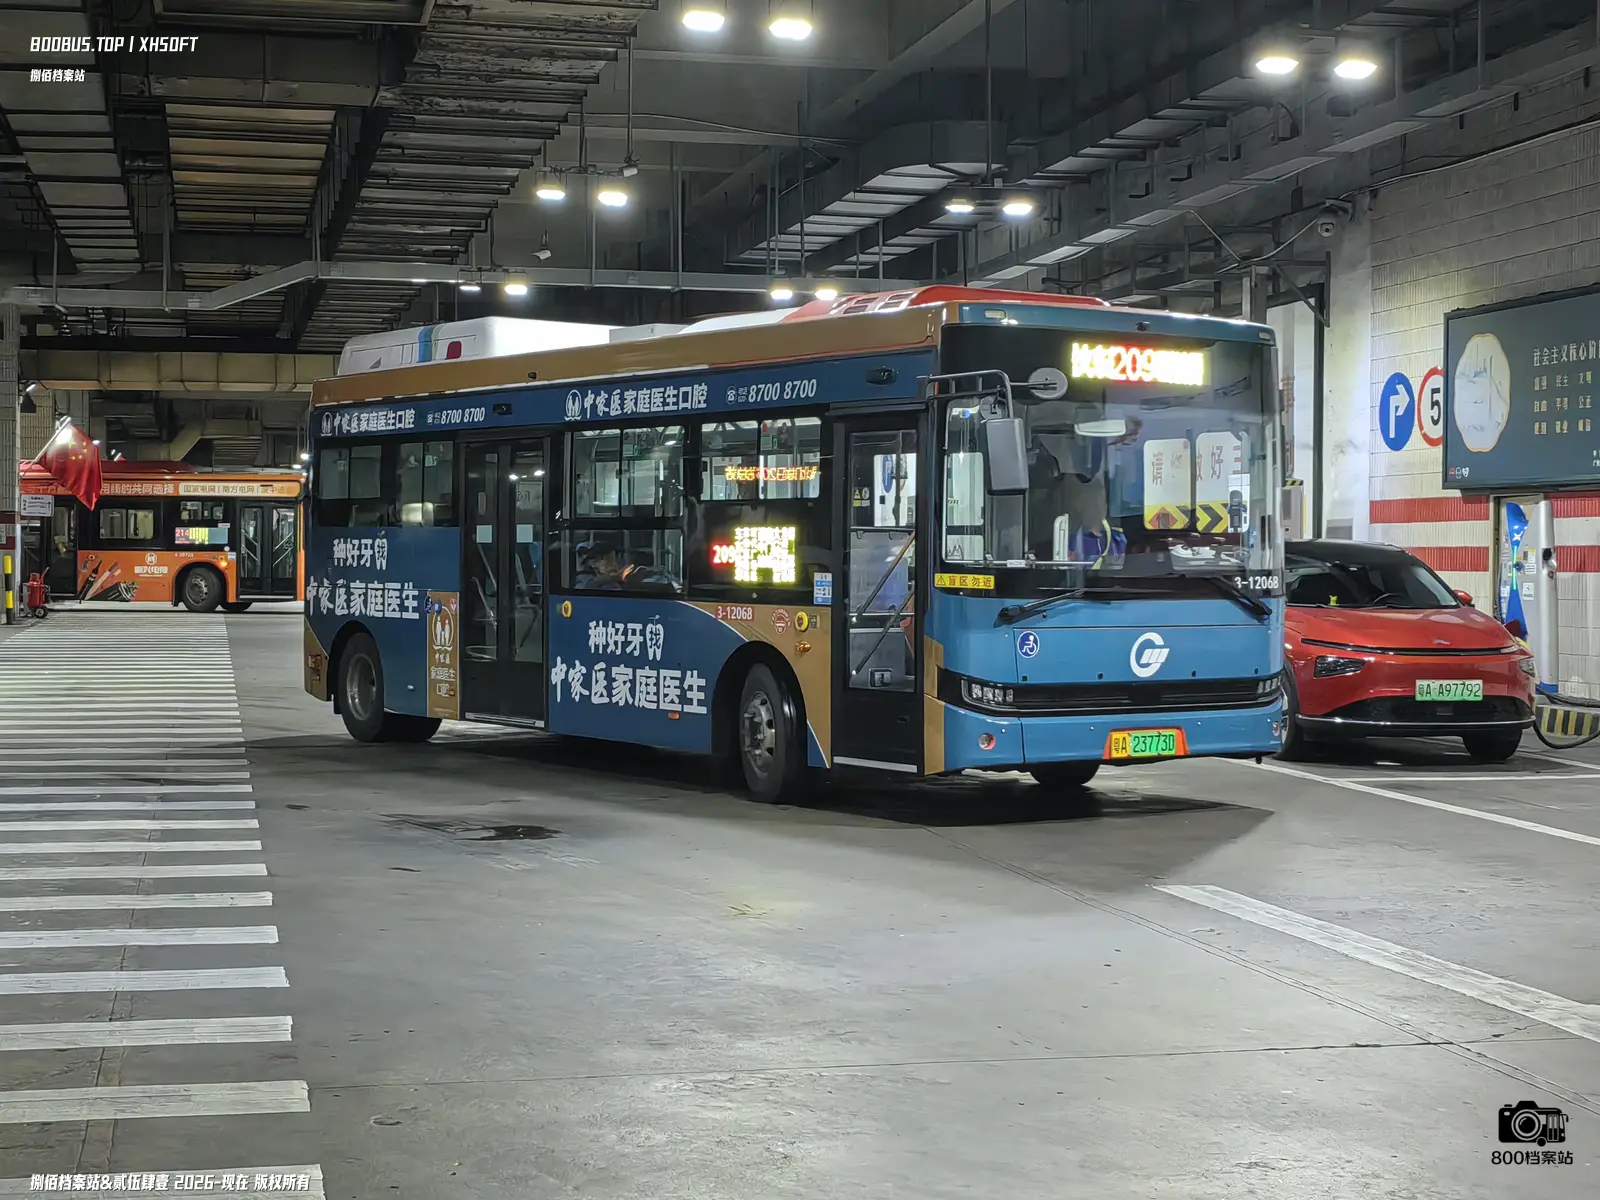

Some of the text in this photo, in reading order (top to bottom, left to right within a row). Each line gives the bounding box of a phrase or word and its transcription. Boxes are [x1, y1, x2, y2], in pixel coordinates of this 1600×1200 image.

[1533, 340, 1600, 366] 社会主义核心价
[748, 382, 780, 403] 8700
[784, 379, 817, 399] 8700
[441, 410, 462, 424] 8700
[464, 407, 485, 422] 8700
[948, 575, 993, 587] 盲区勿近
[1234, 576, 1279, 589] 3-12068
[717, 605, 753, 620] 3-12068
[1438, 684, 1481, 697] A97792
